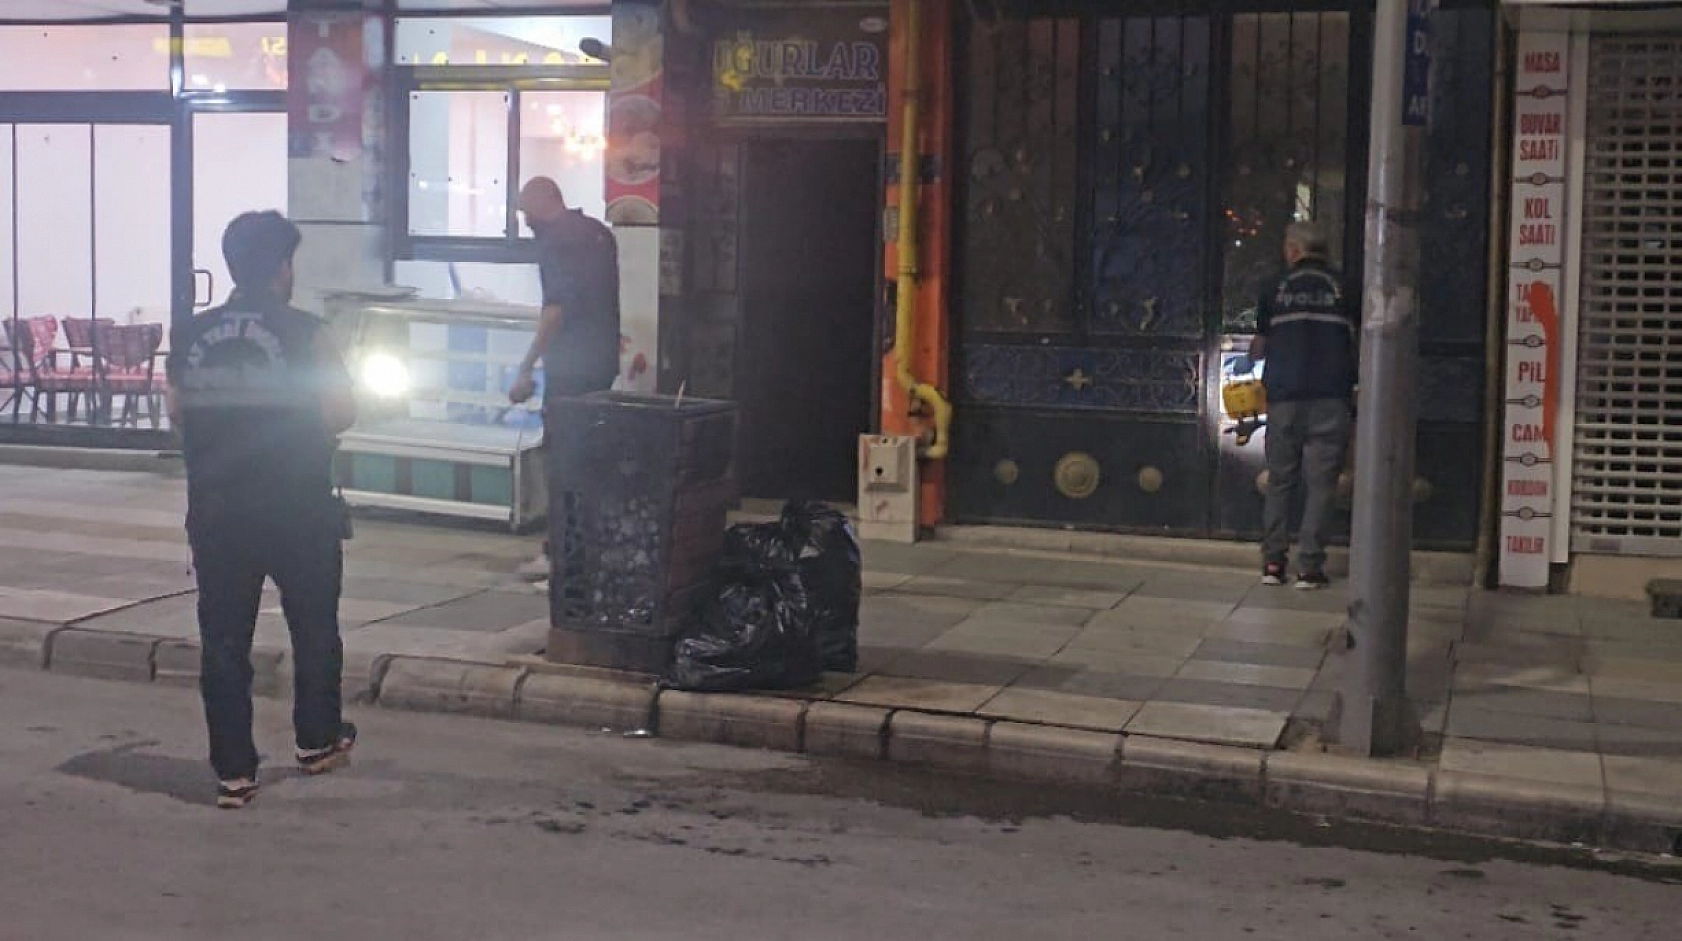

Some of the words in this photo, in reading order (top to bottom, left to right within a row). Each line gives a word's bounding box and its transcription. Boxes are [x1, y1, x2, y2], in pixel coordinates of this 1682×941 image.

[1524, 51, 1560, 72] MASA
[1521, 113, 1561, 134] DUVAR
[1520, 139, 1558, 161] SAATİ
[1524, 197, 1553, 218] KOL
[1520, 224, 1556, 245] SAATİ
[1518, 360, 1546, 382] PİL
